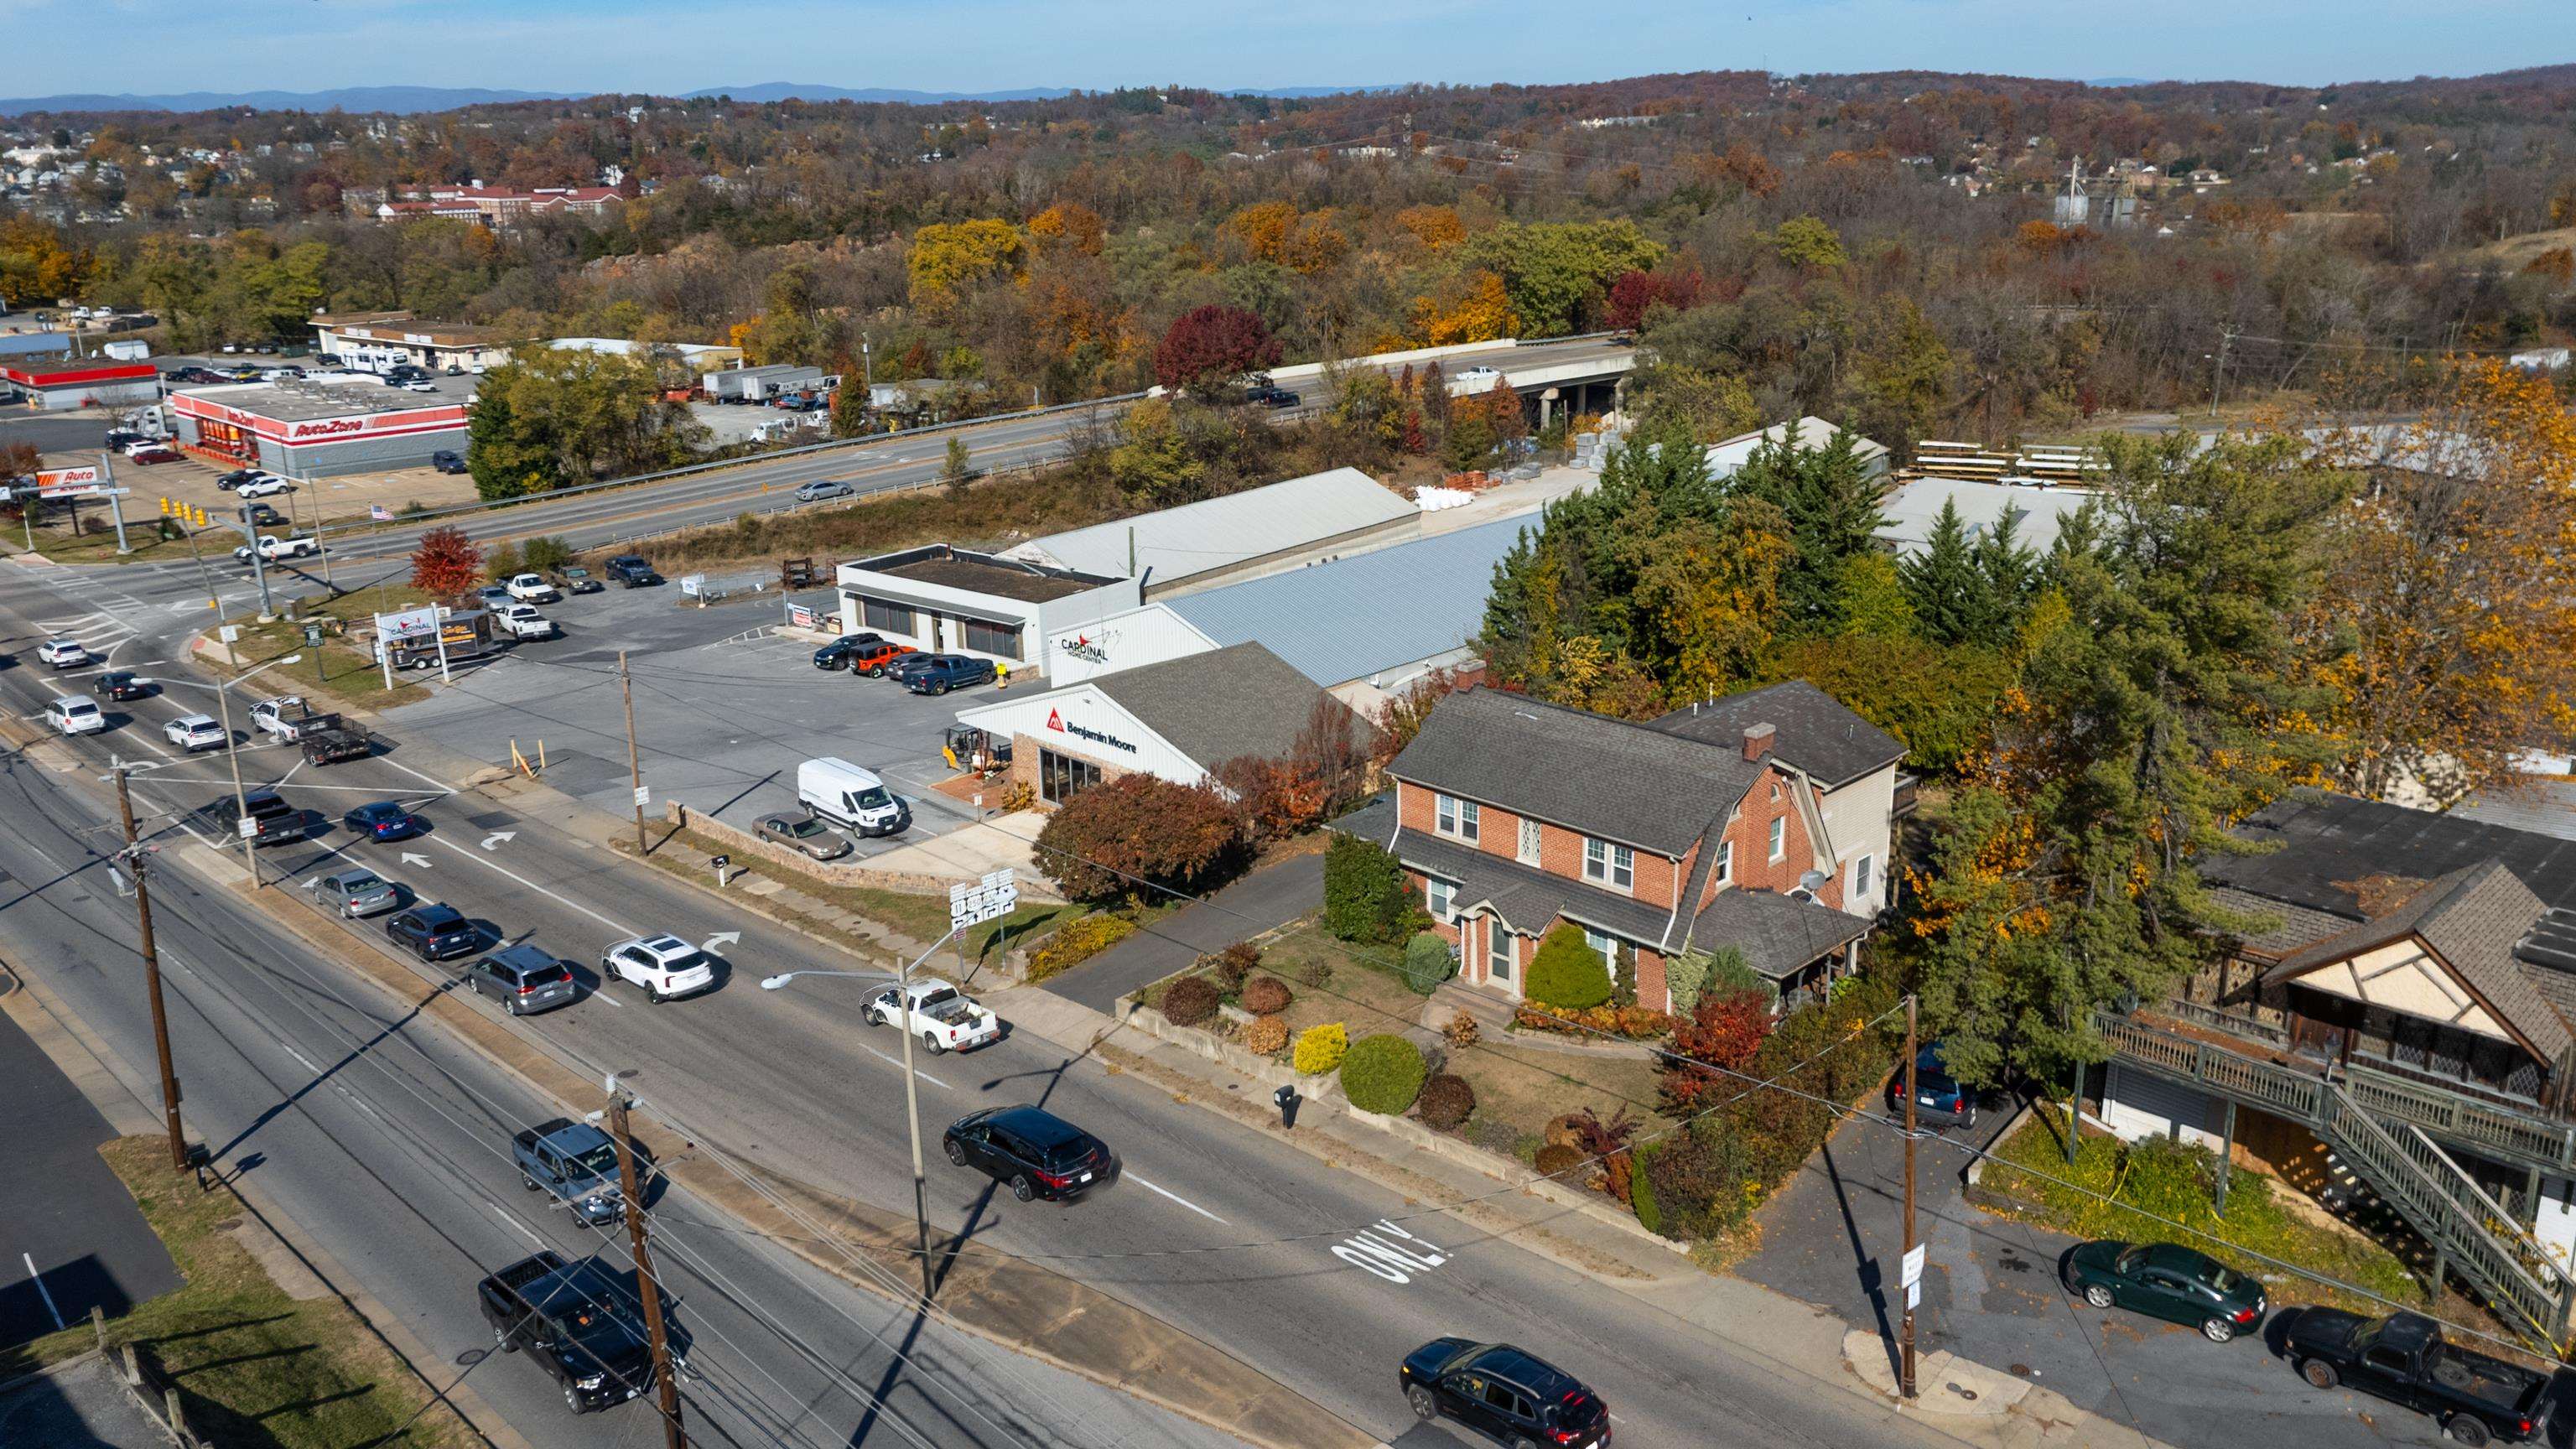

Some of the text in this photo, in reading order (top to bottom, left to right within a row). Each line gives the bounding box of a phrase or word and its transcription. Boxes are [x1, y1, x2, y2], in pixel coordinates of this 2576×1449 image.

[295, 420, 363, 437] AutoZone
[65, 471, 94, 481] Auto
[391, 622, 432, 636] CARDINAL
[1062, 639, 1109, 661] CARDINAL
[1067, 650, 1102, 664] HOME CENTER
[1067, 721, 1137, 753] Benjamin Moore
[955, 903, 963, 914] 11
[1331, 1218, 1454, 1284] ONLY
